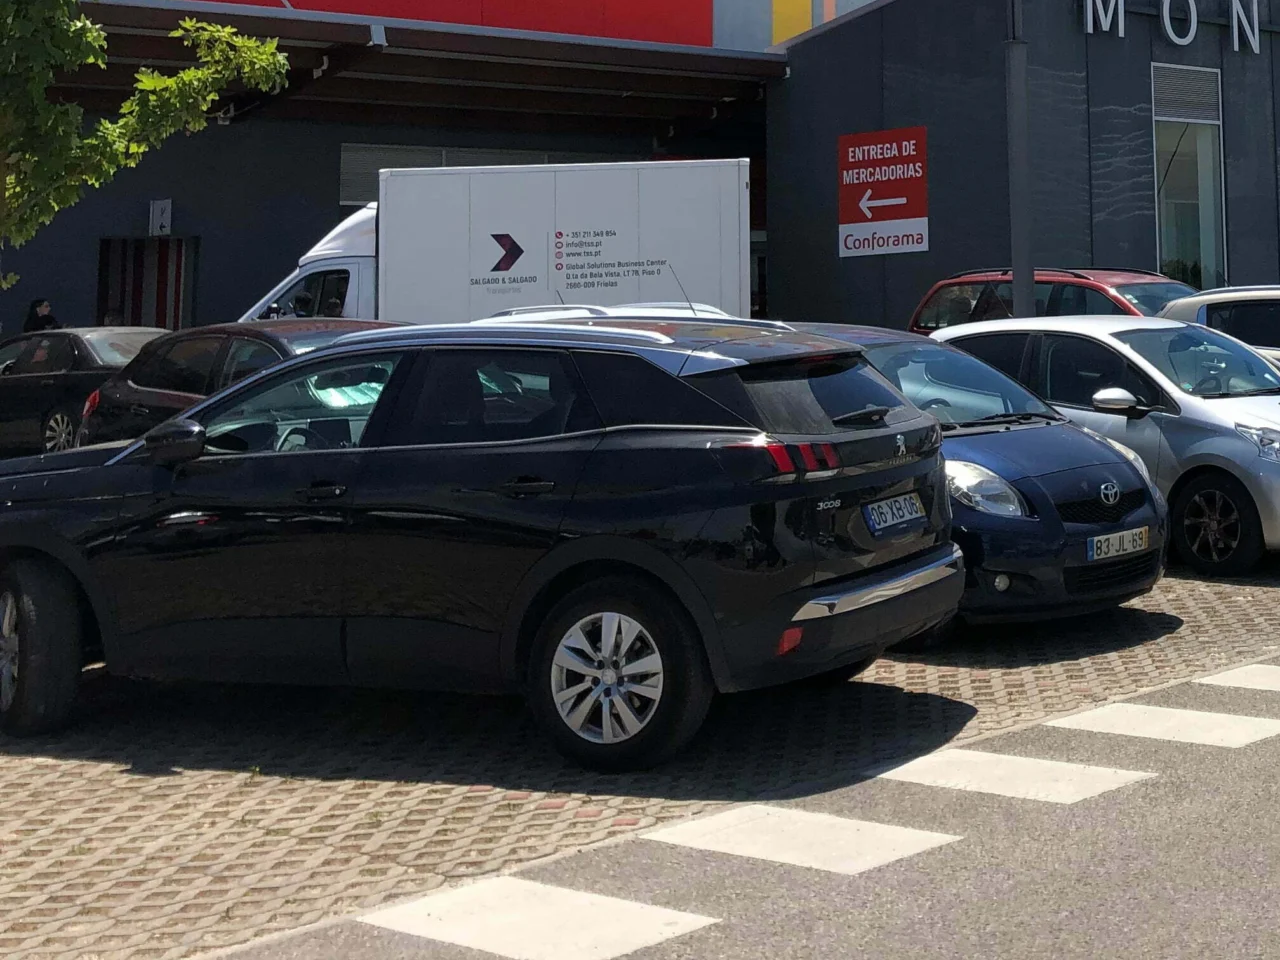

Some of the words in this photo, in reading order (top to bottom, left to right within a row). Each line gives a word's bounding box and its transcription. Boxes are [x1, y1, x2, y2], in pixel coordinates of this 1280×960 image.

[848, 142, 899, 162] ENTREGA
[902, 140, 917, 156] DE
[843, 162, 923, 185] MERCADORIAS
[565, 240, 602, 249] info@tss.pt
[843, 232, 924, 251] Conforama
[565, 250, 601, 258] www.tss.pt
[566, 263, 586, 271] Global
[587, 261, 616, 270] Solutions
[617, 260, 645, 268] Business
[646, 259, 667, 267] Center
[470, 277, 500, 286] SALGADO
[508, 275, 537, 284] SALGADO
[816, 499, 841, 511] 3008
[871, 496, 919, 526] 06-XB-06
[1095, 531, 1143, 556] 83-JL-69
